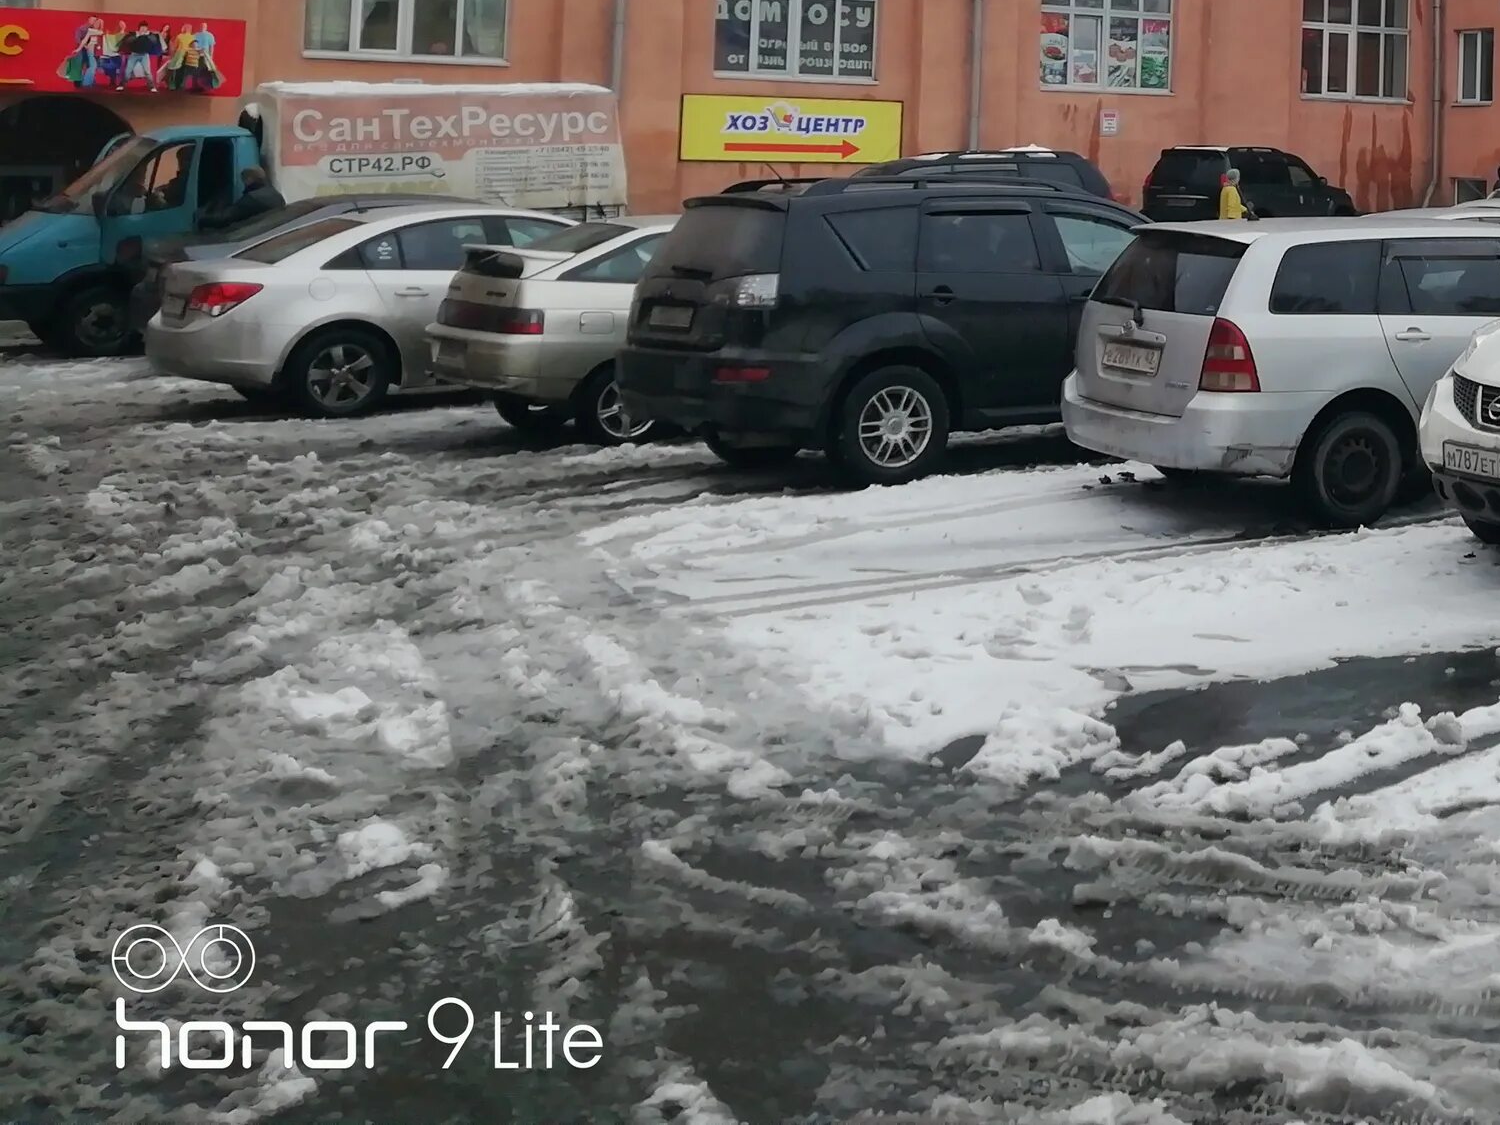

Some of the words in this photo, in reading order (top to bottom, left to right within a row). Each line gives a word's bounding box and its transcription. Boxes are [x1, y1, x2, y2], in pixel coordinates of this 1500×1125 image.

[292, 106, 609, 143] СанТехРесурс
[726, 114, 769, 131] ХОЗ
[796, 116, 865, 134] ЦЕНТР
[329, 156, 431, 174] СТР42.РФ
